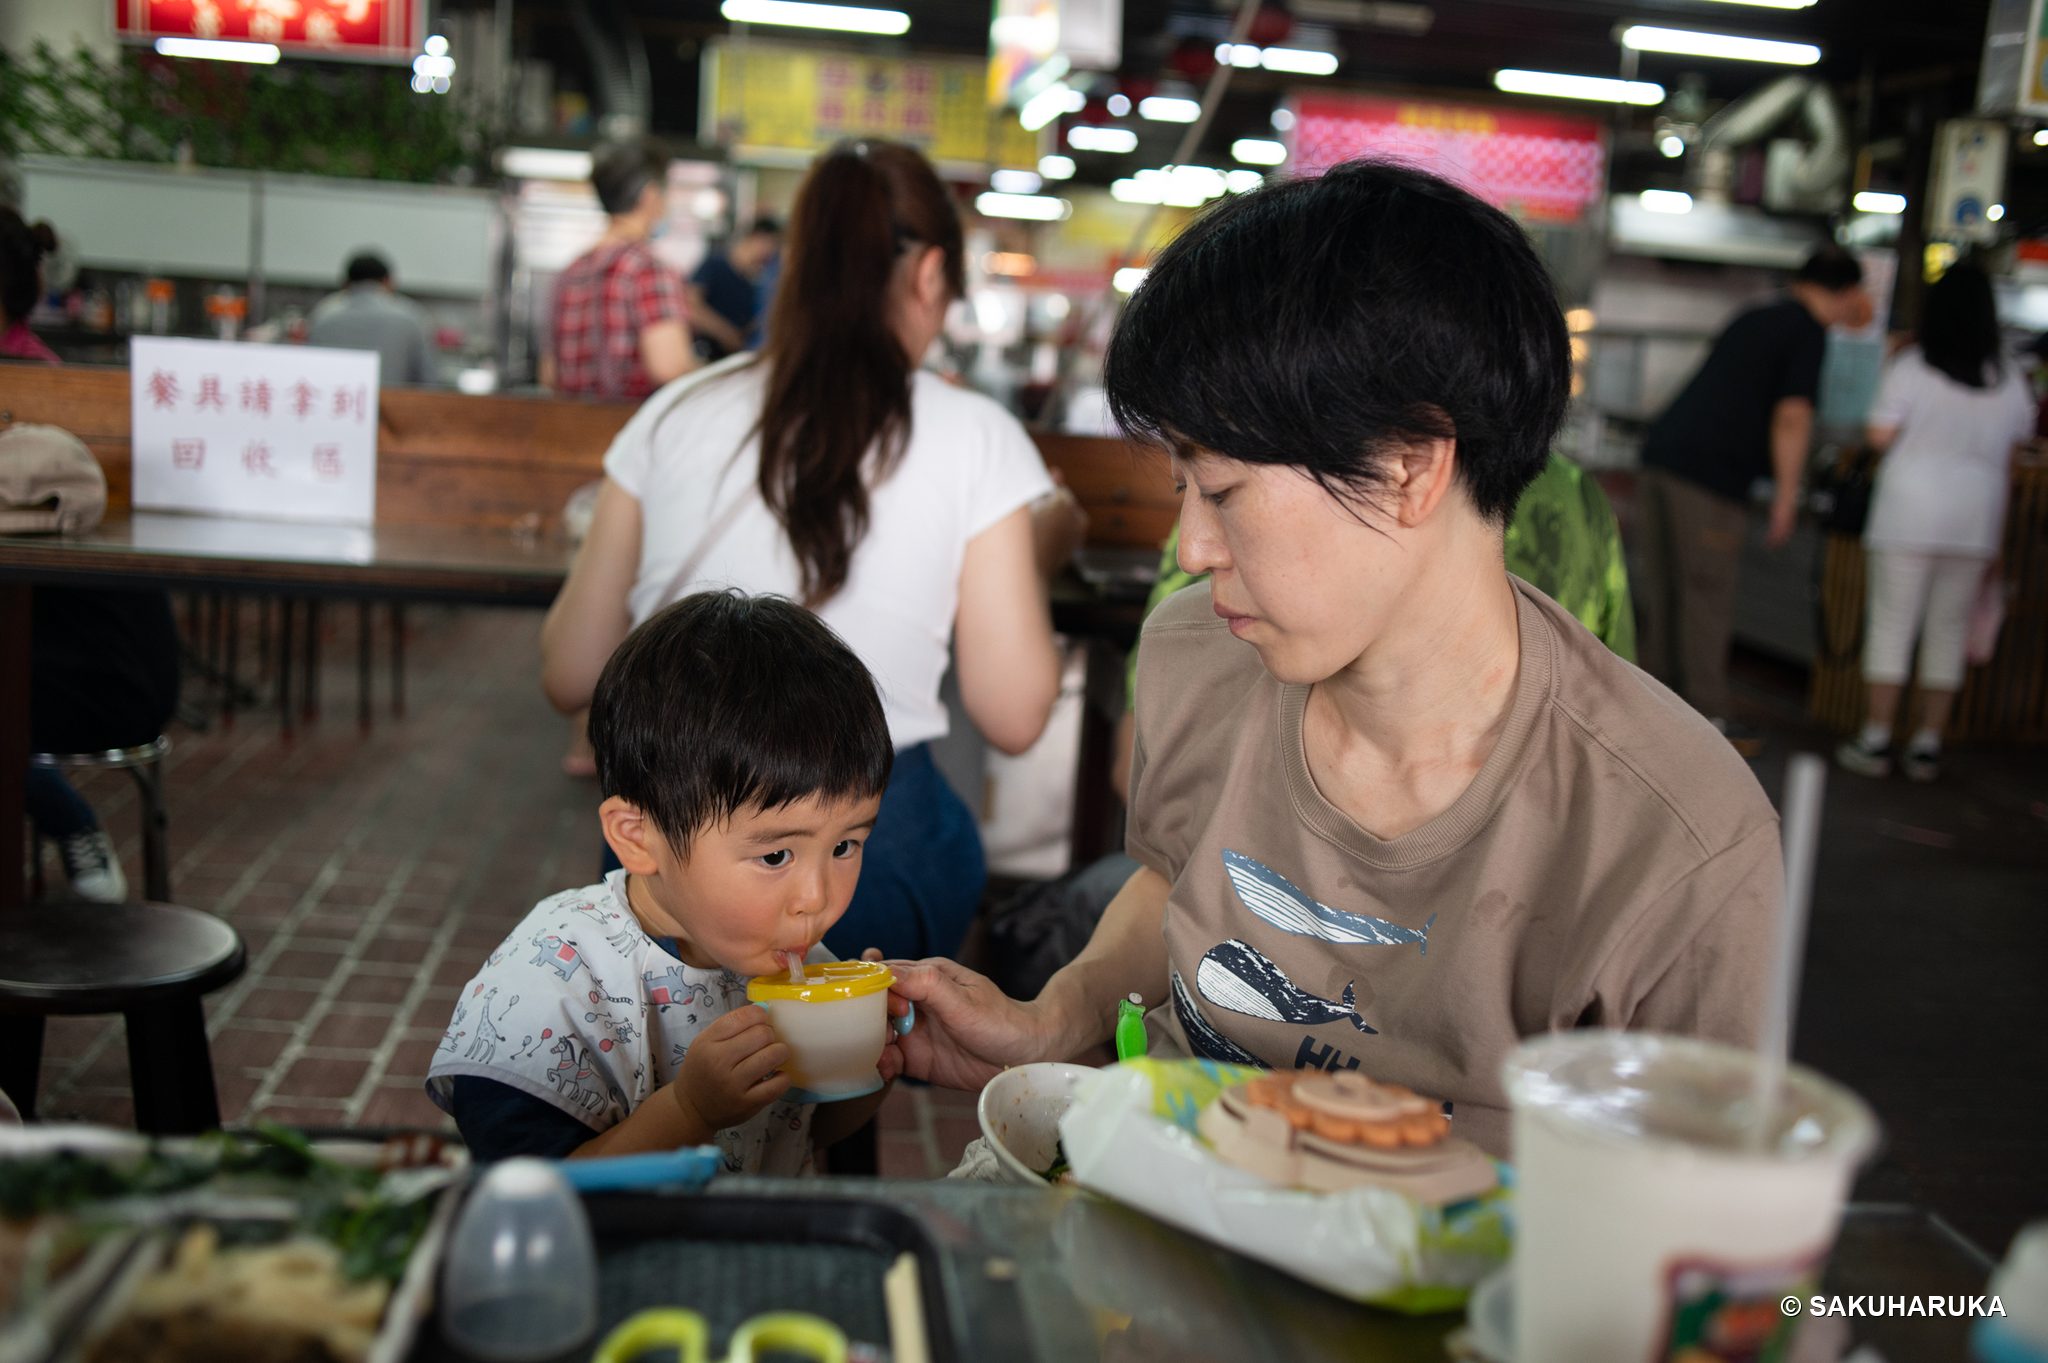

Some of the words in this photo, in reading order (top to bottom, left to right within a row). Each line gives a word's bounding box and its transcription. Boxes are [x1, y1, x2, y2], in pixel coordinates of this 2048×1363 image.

[147, 367, 367, 424] 餐具請拿到
